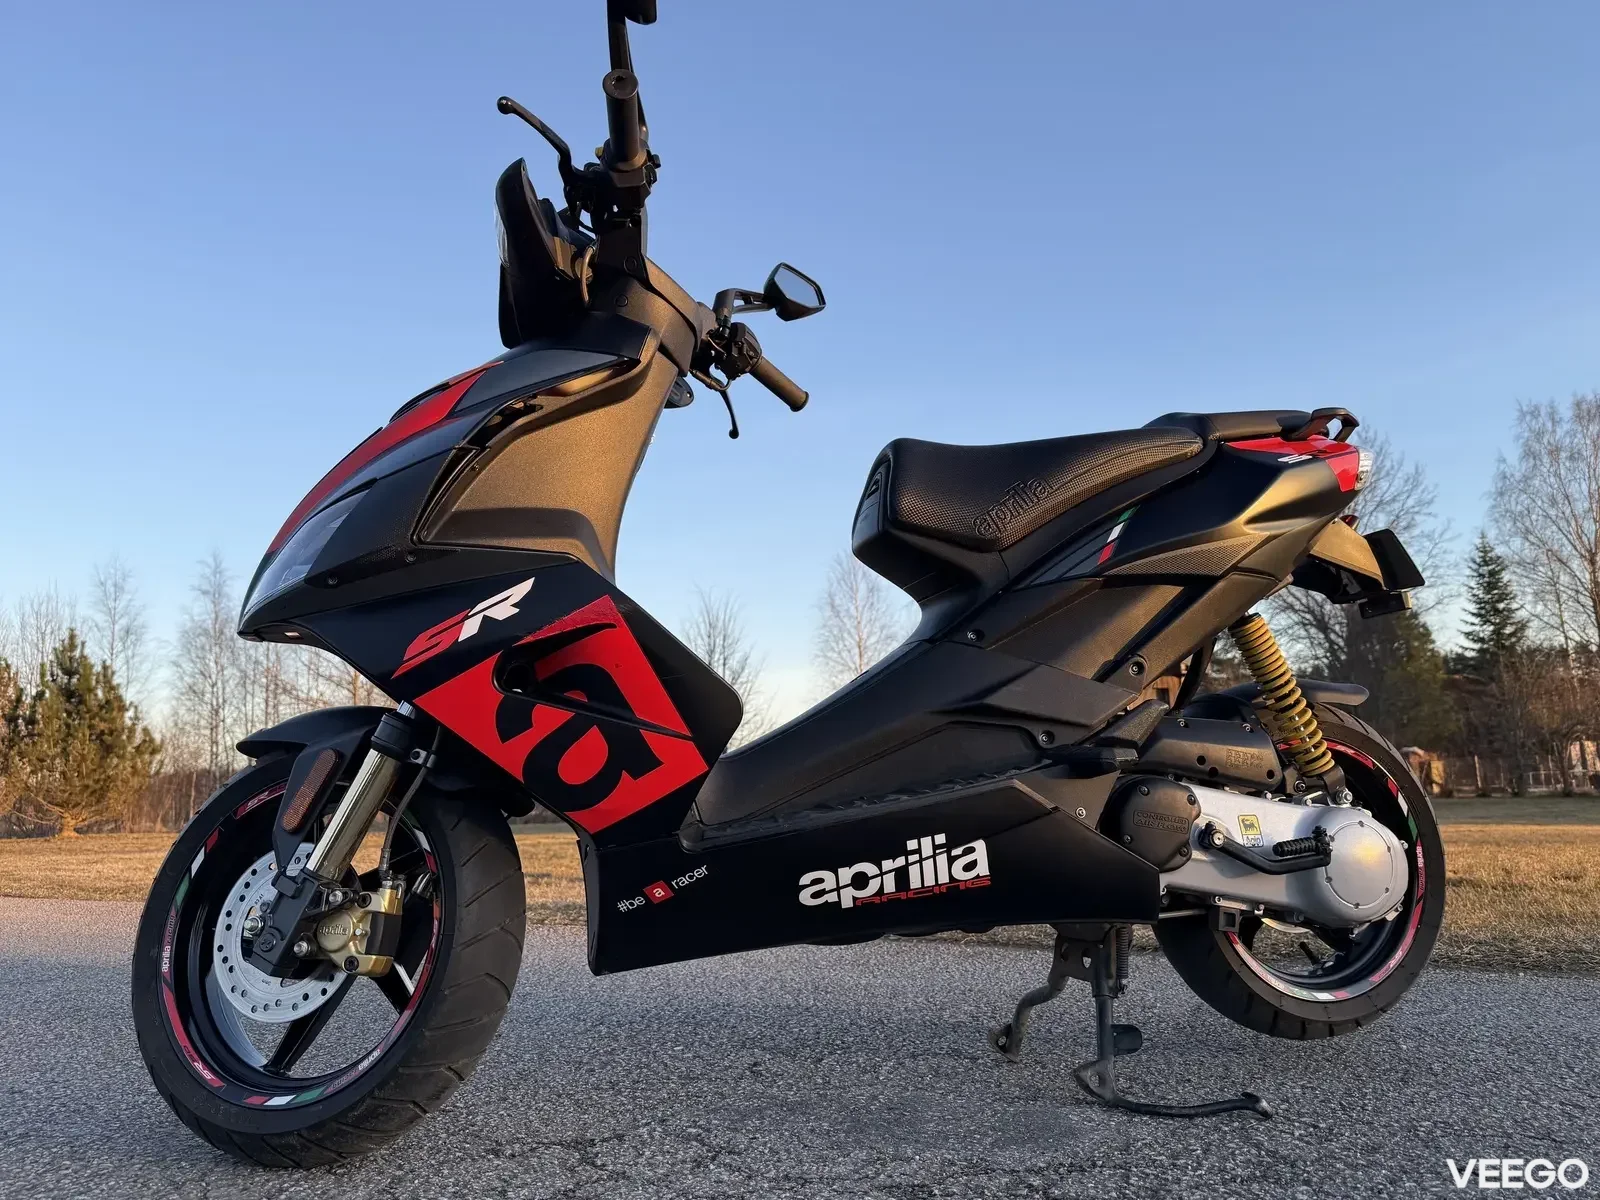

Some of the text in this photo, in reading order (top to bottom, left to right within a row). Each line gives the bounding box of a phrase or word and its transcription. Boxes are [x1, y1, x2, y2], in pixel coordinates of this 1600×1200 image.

[972, 478, 1053, 540] aprilia
[391, 577, 535, 679] SR
[617, 864, 709, 913] #be a racer
[798, 833, 990, 909] aprilia
[162, 945, 171, 972] aprilia
